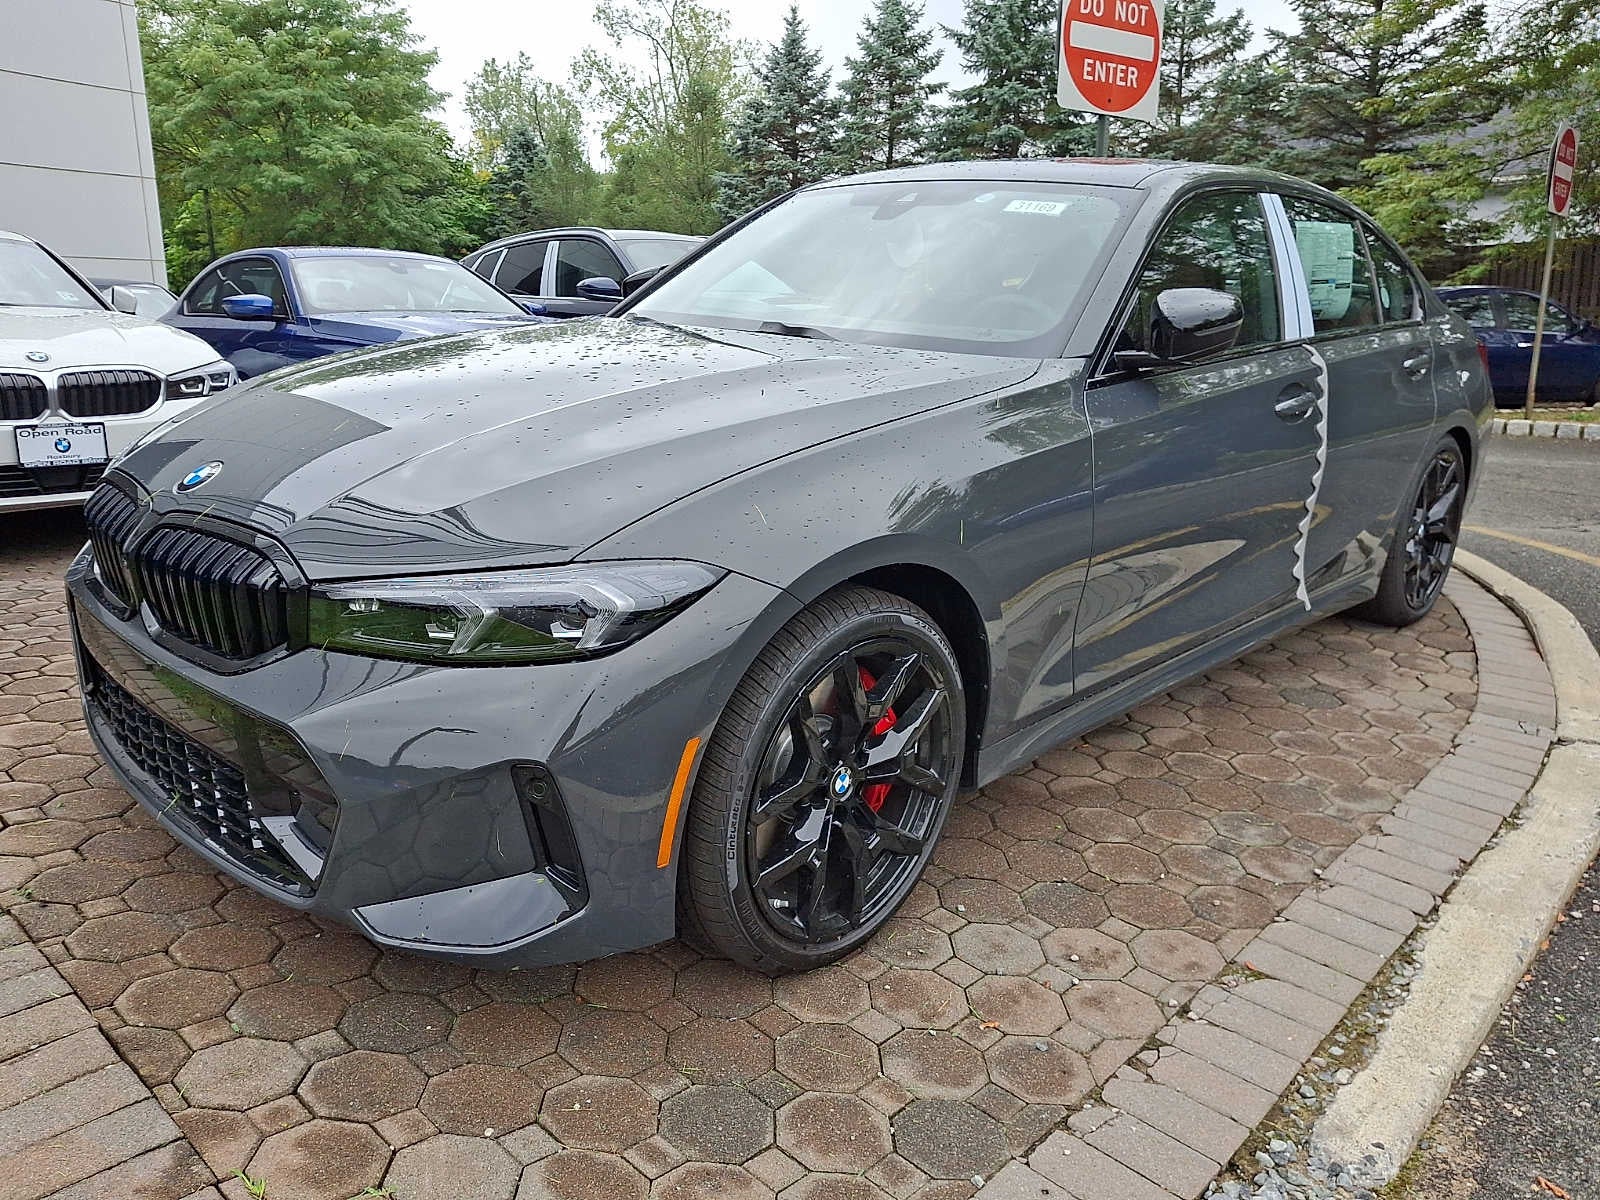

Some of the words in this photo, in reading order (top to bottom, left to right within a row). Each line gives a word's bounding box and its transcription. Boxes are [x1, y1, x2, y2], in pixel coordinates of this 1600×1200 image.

[1080, 0, 1104, 17] DO
[1115, 1, 1149, 26] NOT
[1083, 58, 1138, 88] ENTER
[1015, 201, 1056, 212] 31169
[19, 429, 59, 438] Open
[65, 427, 101, 435] Road
